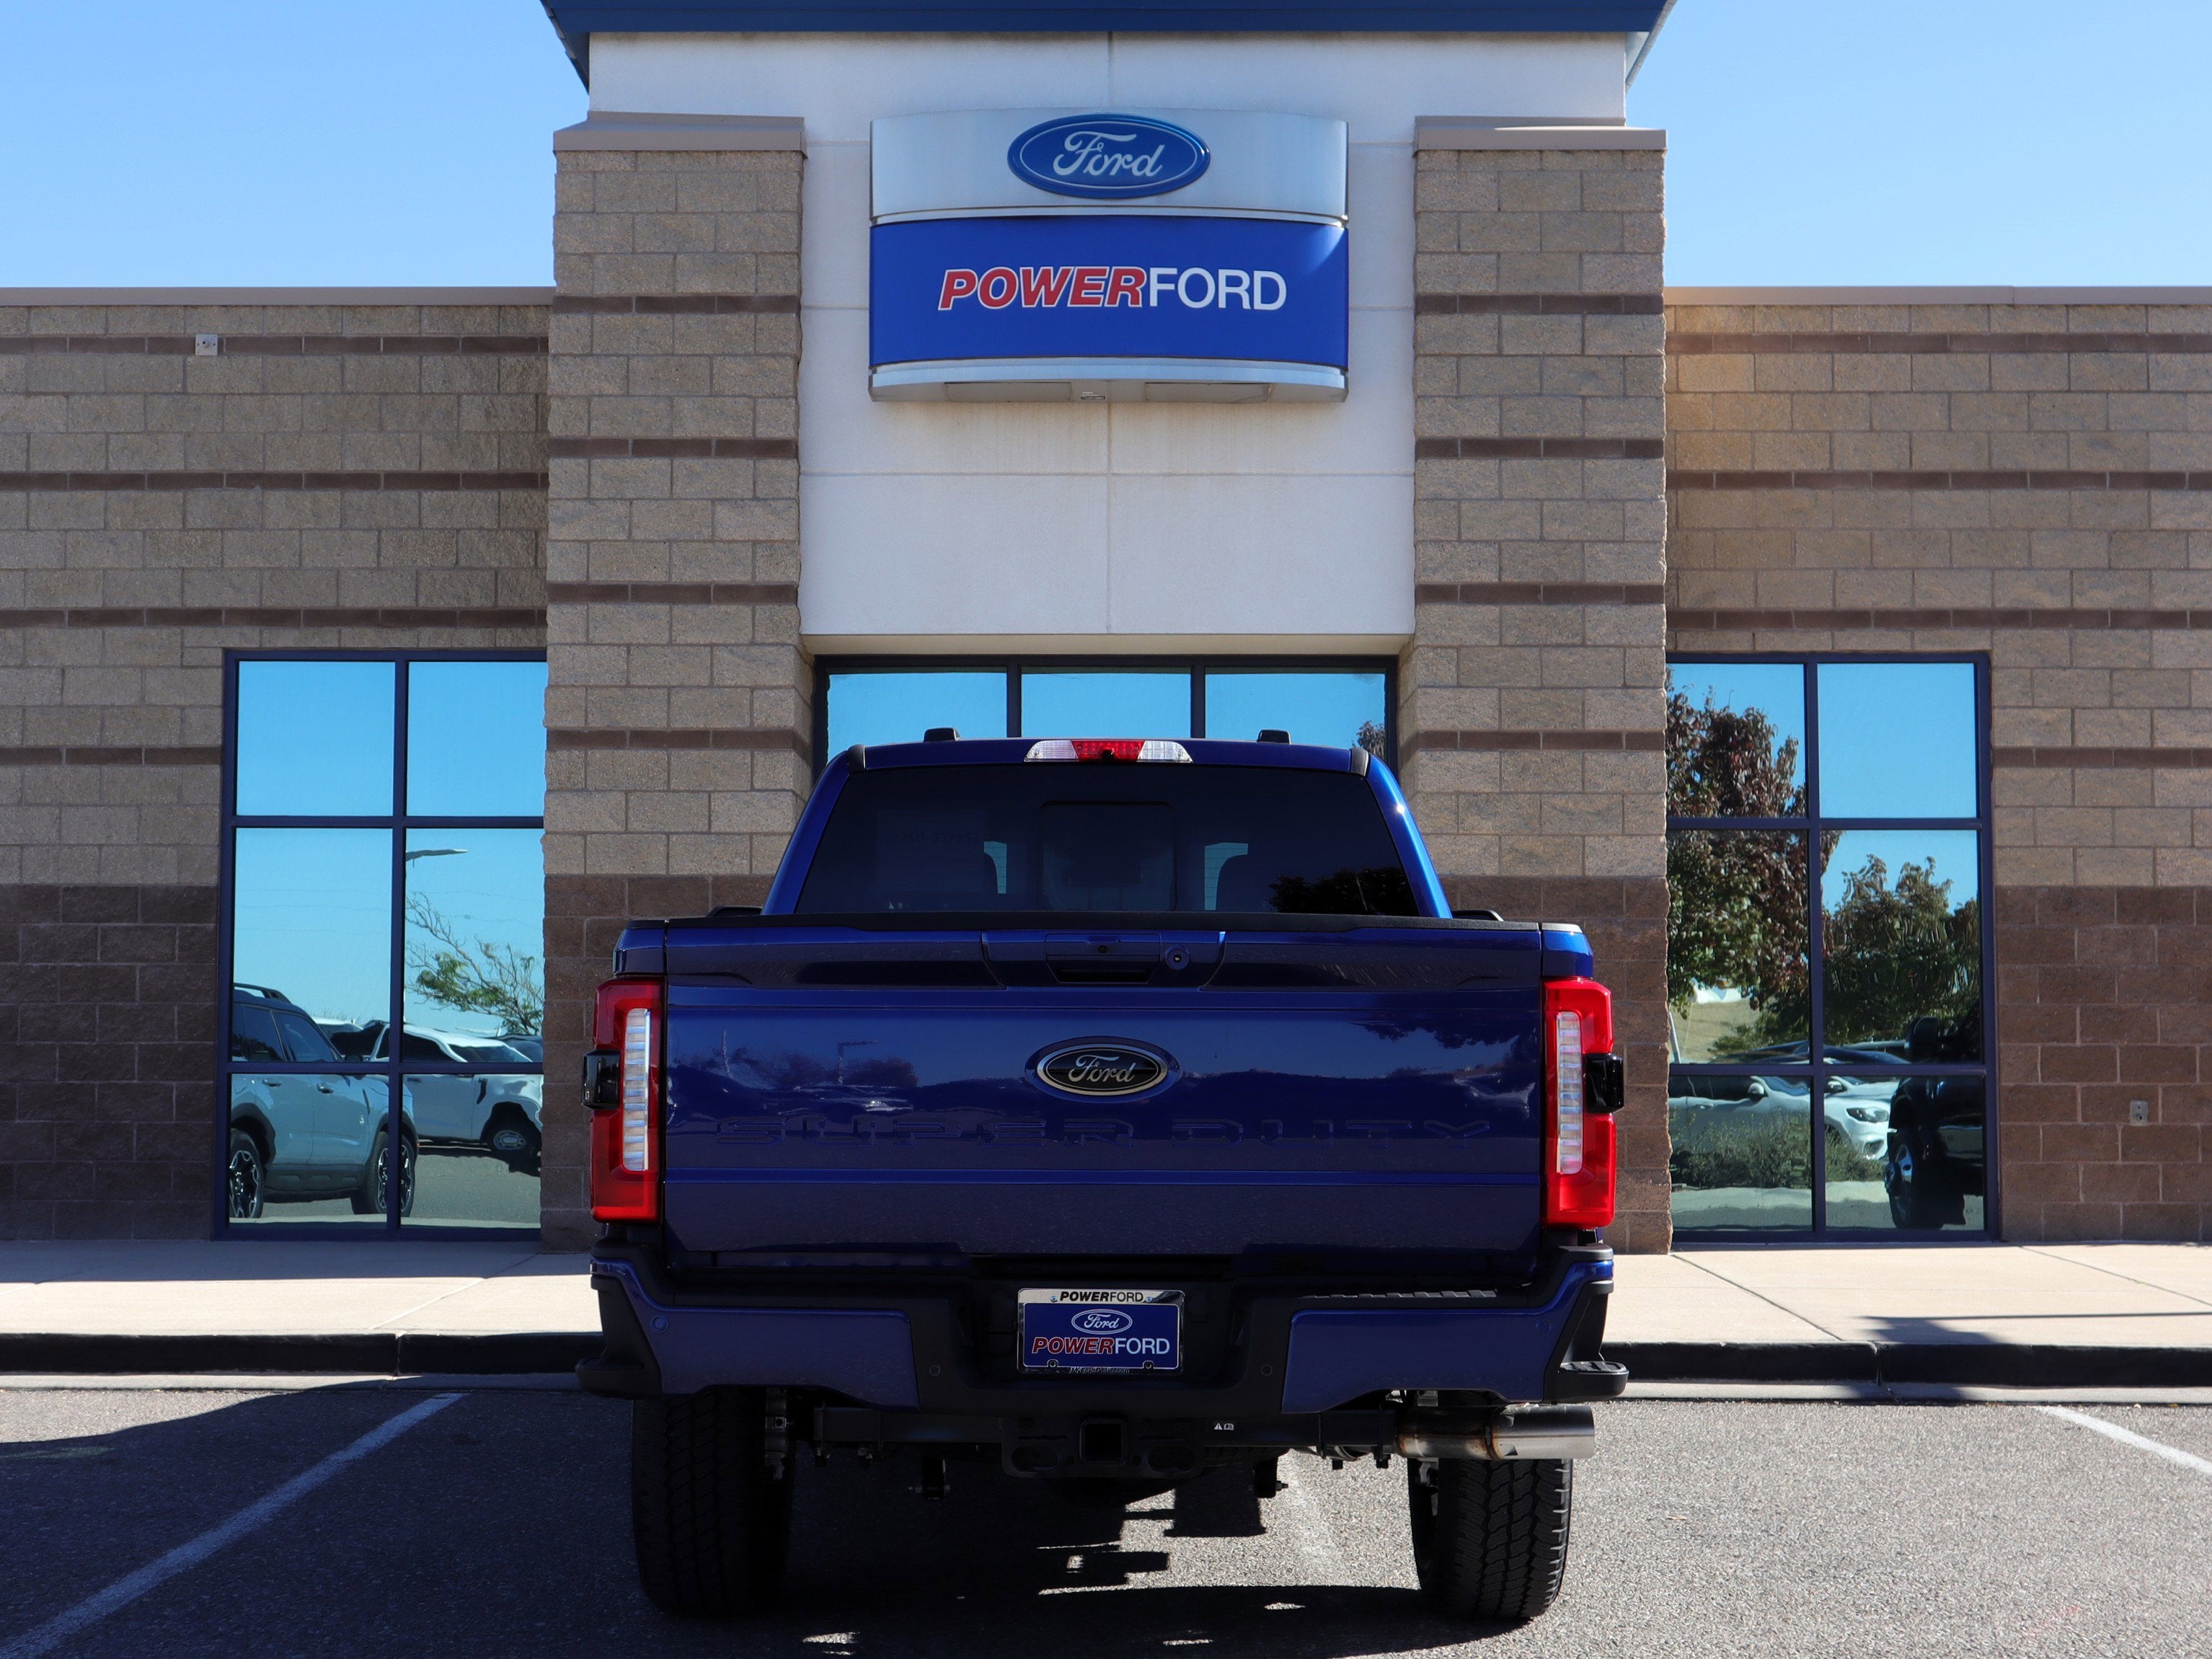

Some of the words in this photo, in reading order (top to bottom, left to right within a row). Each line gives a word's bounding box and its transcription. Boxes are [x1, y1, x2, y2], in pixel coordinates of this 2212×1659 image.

[1053, 130, 1163, 177] Ford
[1068, 1054, 1136, 1082] Ford
[715, 1115, 1133, 1148] SUPER
[1174, 1118, 1491, 1149] DUTY
[1084, 1313, 1120, 1329] Ford
